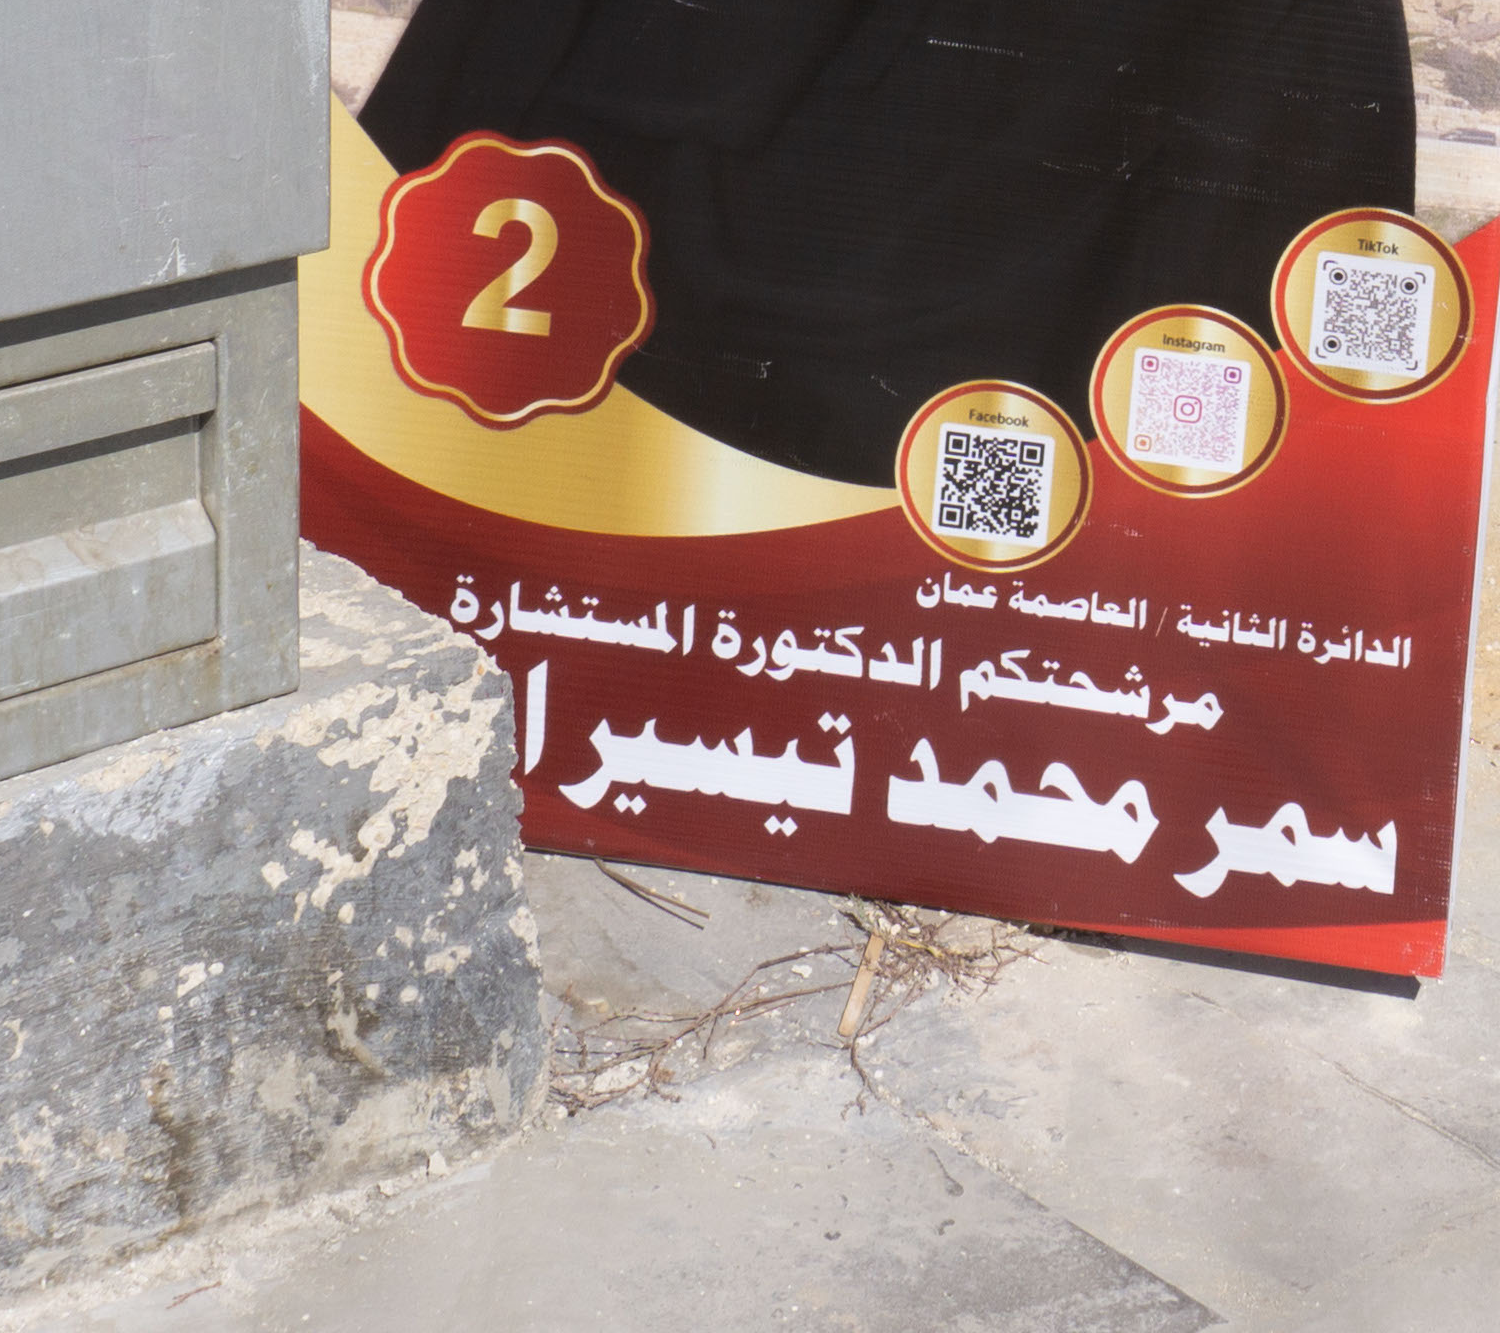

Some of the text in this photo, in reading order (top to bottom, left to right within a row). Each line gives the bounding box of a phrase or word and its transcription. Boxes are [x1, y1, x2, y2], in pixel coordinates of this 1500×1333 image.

[461, 198, 558, 336] 2
[1357, 238, 1399, 255] TikTok
[1163, 333, 1226, 353] Instagram
[968, 408, 1029, 428] Facebook
[915, 572, 999, 609] عمان
[1008, 580, 1148, 631] العاصمة
[1176, 604, 1287, 651] الثانية
[1296, 622, 1411, 669] الدائرة
[450, 574, 1225, 735] مرشحتكم الدكتورة المستشارة
[558, 711, 856, 837] تيسير
[887, 737, 1160, 864] محمد
[1173, 802, 1398, 898] سمر
